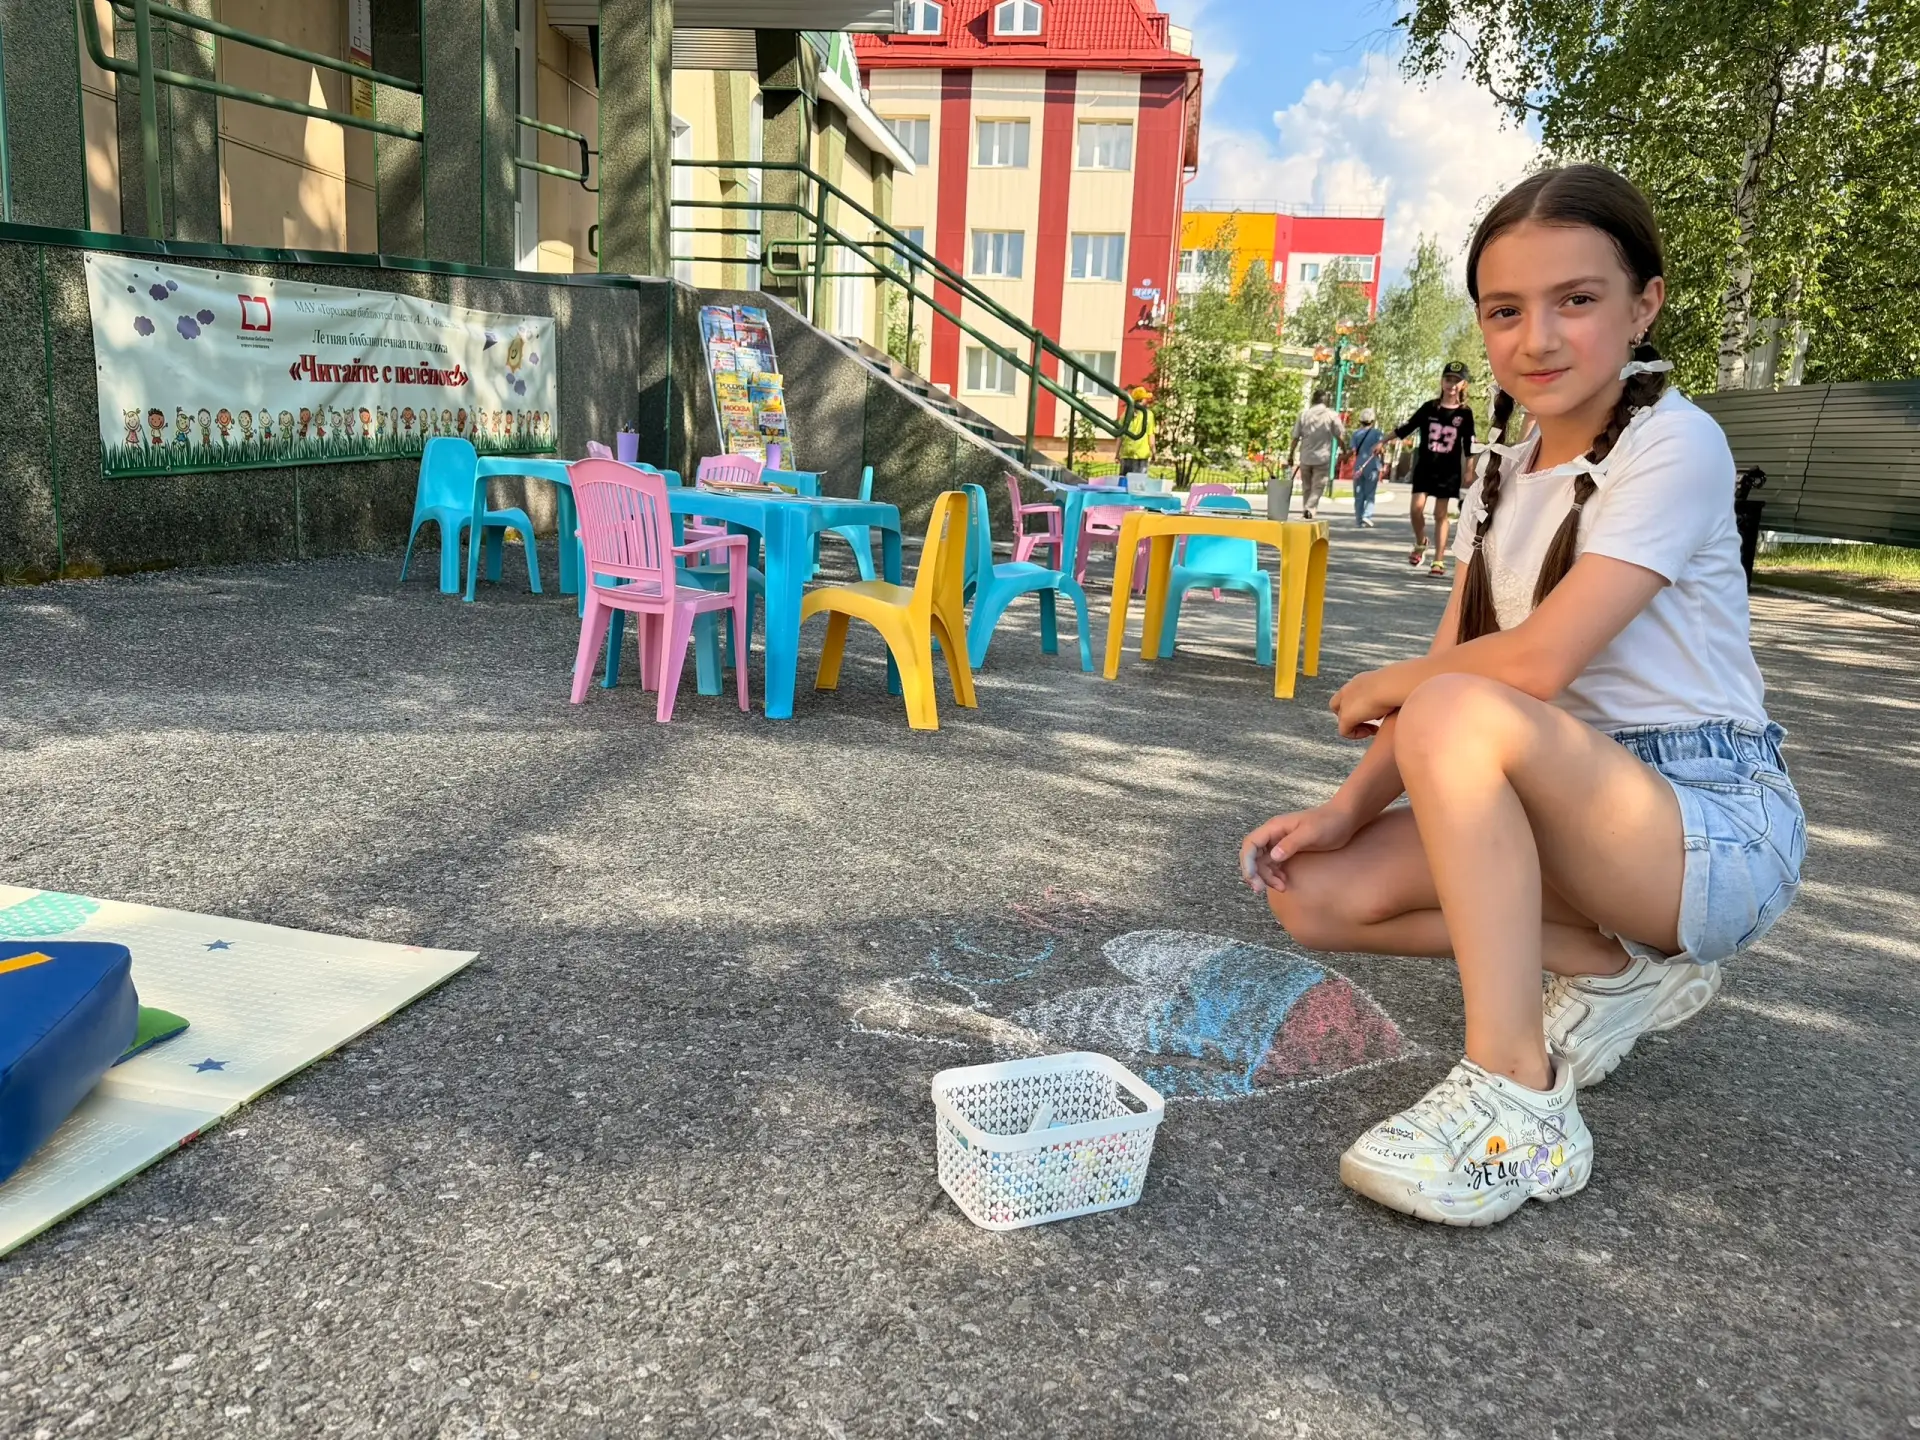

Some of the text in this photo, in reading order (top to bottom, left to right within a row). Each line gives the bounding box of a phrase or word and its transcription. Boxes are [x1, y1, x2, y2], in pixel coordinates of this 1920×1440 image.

[294, 301, 315, 313] МАУ
[312, 330, 448, 354] Летняя библиотечная плоадка
[289, 355, 469, 387] «Читайте с пелёнок!»
